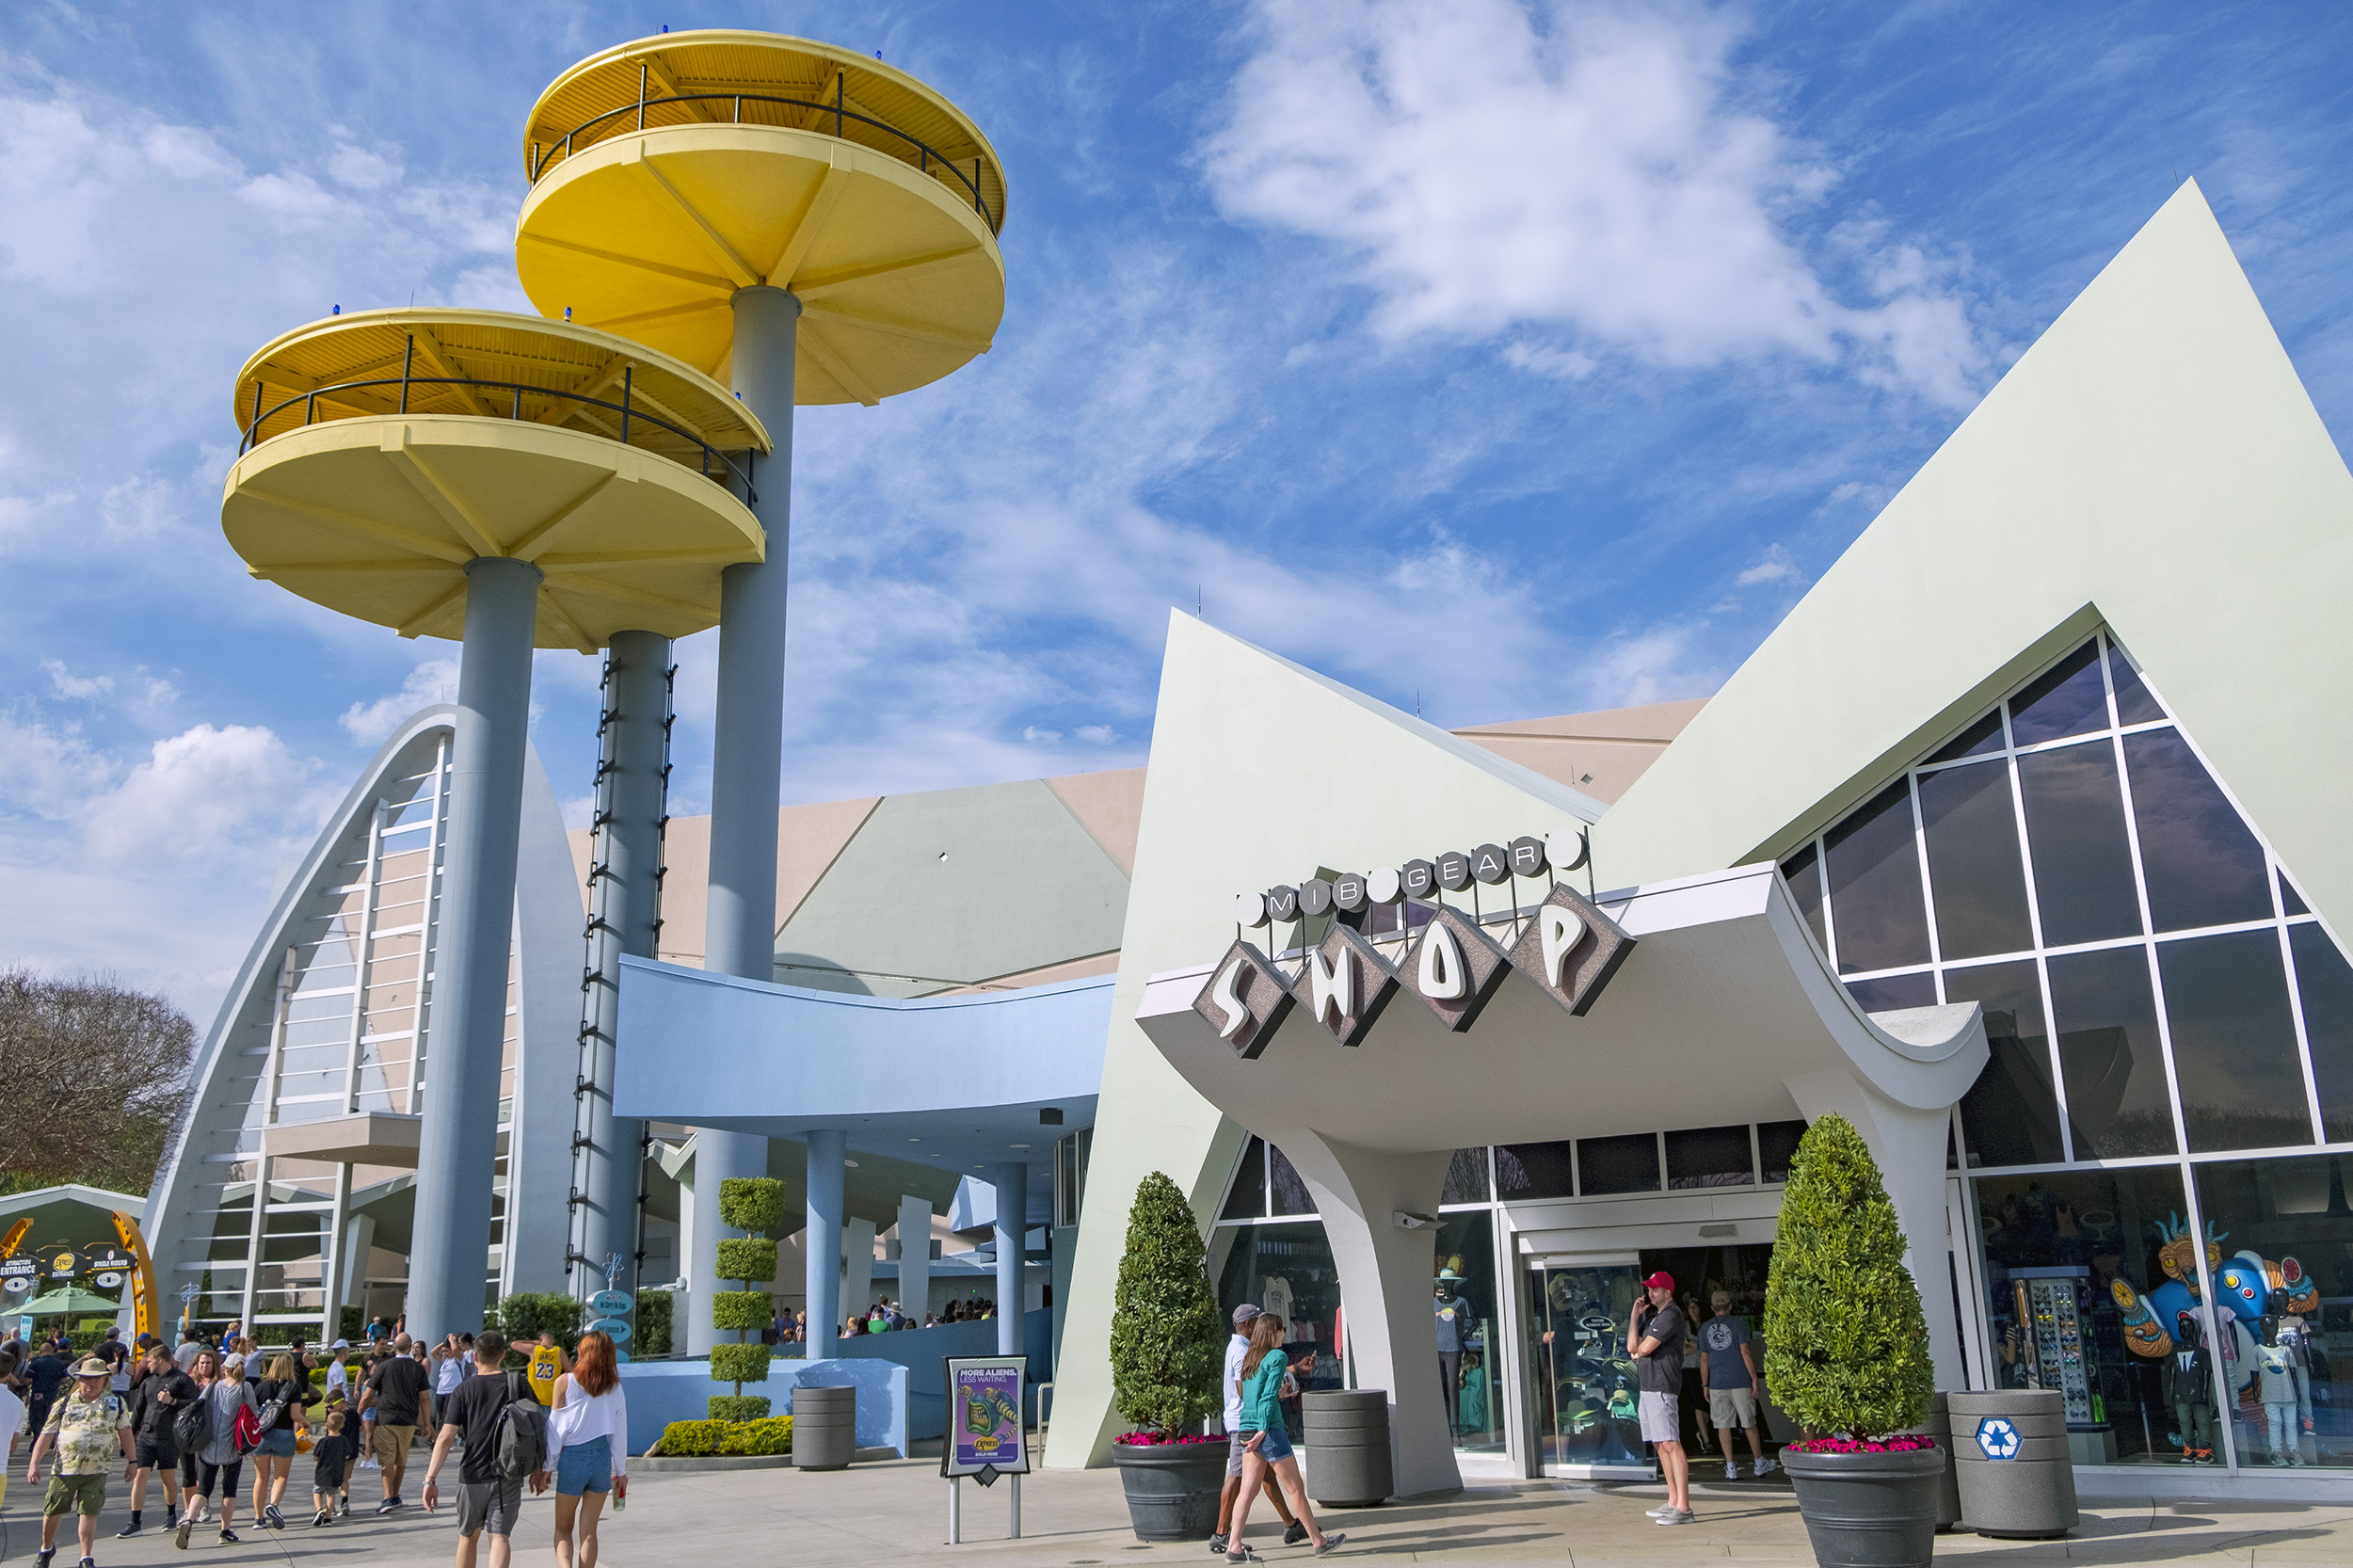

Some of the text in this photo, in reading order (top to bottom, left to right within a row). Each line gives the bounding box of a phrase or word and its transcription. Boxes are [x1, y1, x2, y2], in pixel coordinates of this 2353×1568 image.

[1271, 844, 1536, 913] MIB GEAR
[1211, 904, 1588, 1039] SHOP
[0, 1265, 36, 1275] ENTRANCE
[536, 1362, 554, 1381] 23
[975, 1440, 999, 1450] EXPRESS
